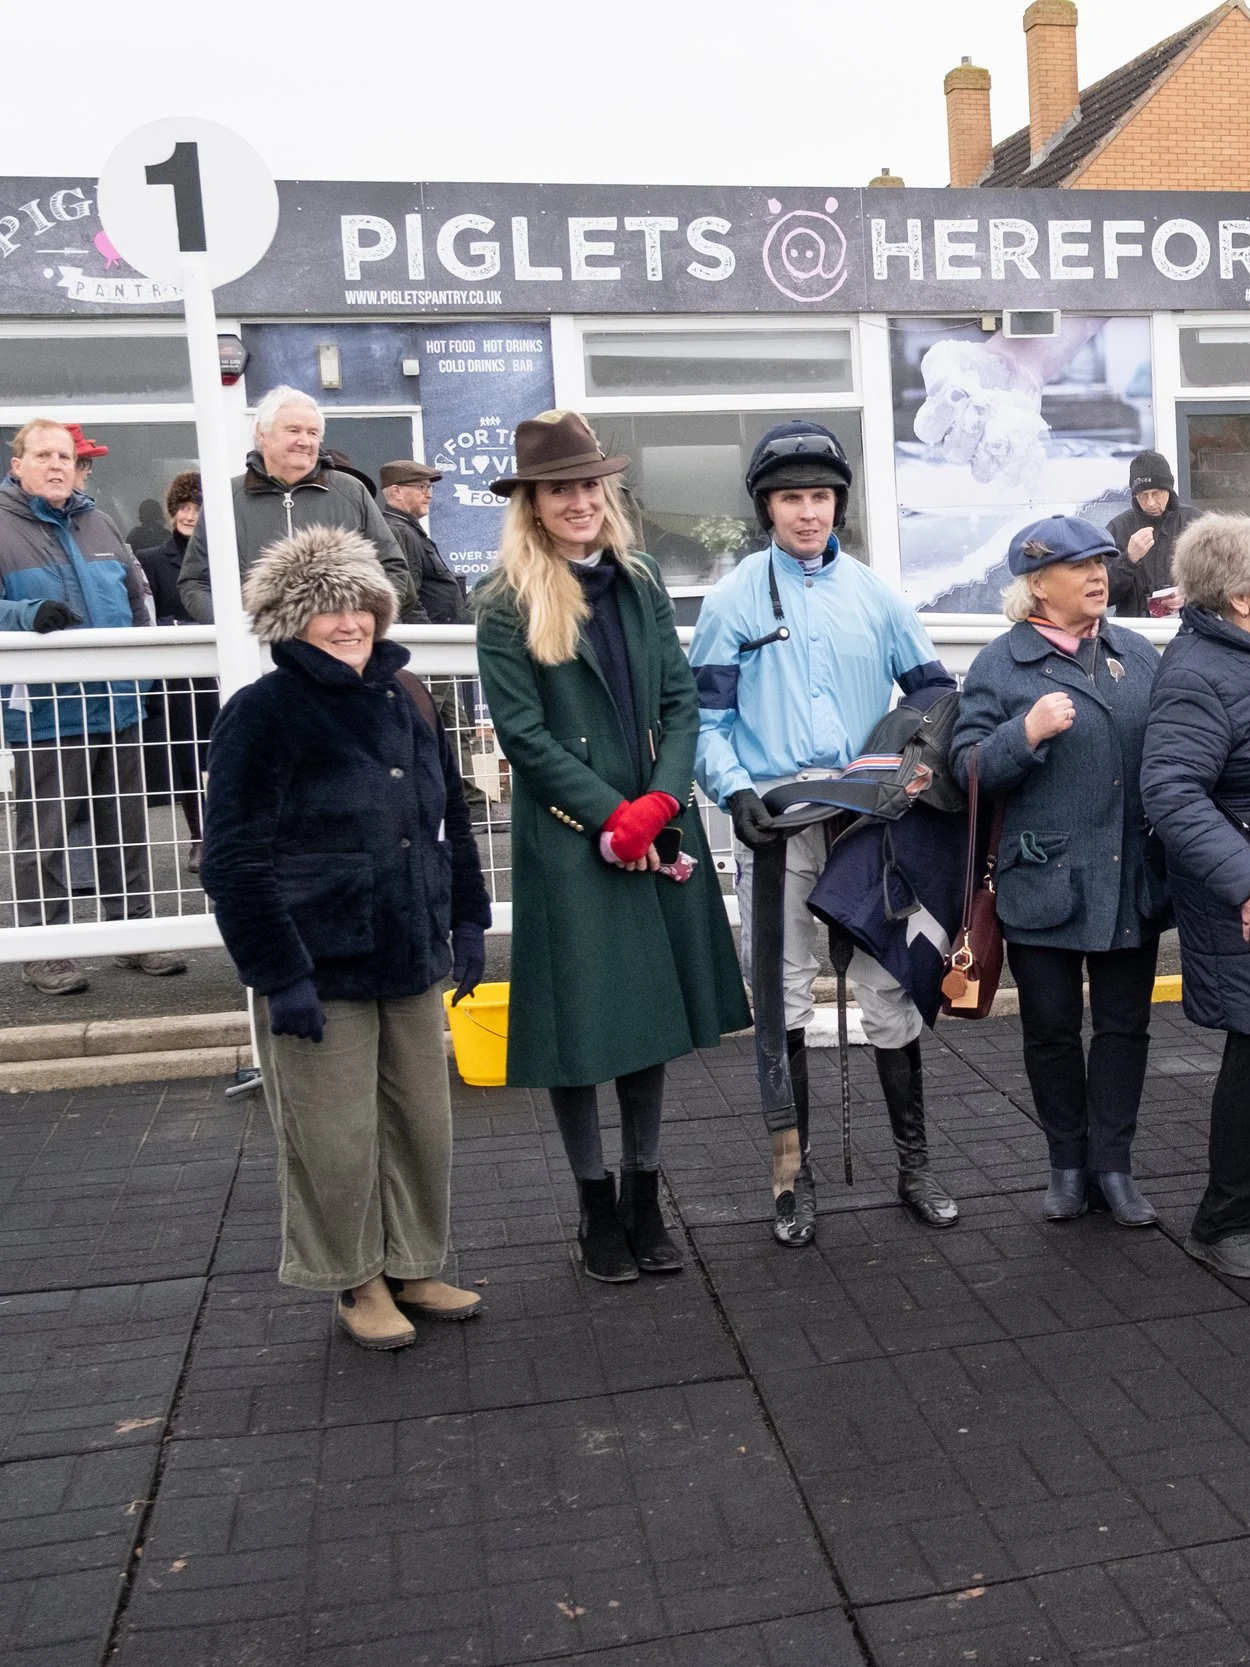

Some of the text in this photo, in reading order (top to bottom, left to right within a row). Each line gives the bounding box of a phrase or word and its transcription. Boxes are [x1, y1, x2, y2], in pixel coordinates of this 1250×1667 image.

[144, 141, 207, 252] 1
[340, 213, 736, 281] PIGLETS
[345, 290, 503, 305] WWW.PIGLETSPANTRY.CO.UK
[426, 339, 543, 353] HOT FOOD HOT DRINKS
[439, 359, 534, 373] COLD DRINKS BAR
[443, 429, 489, 456] FOR
[471, 492, 507, 504] FOO
[449, 551, 483, 561] OVER
[454, 564, 489, 573] FOOD
